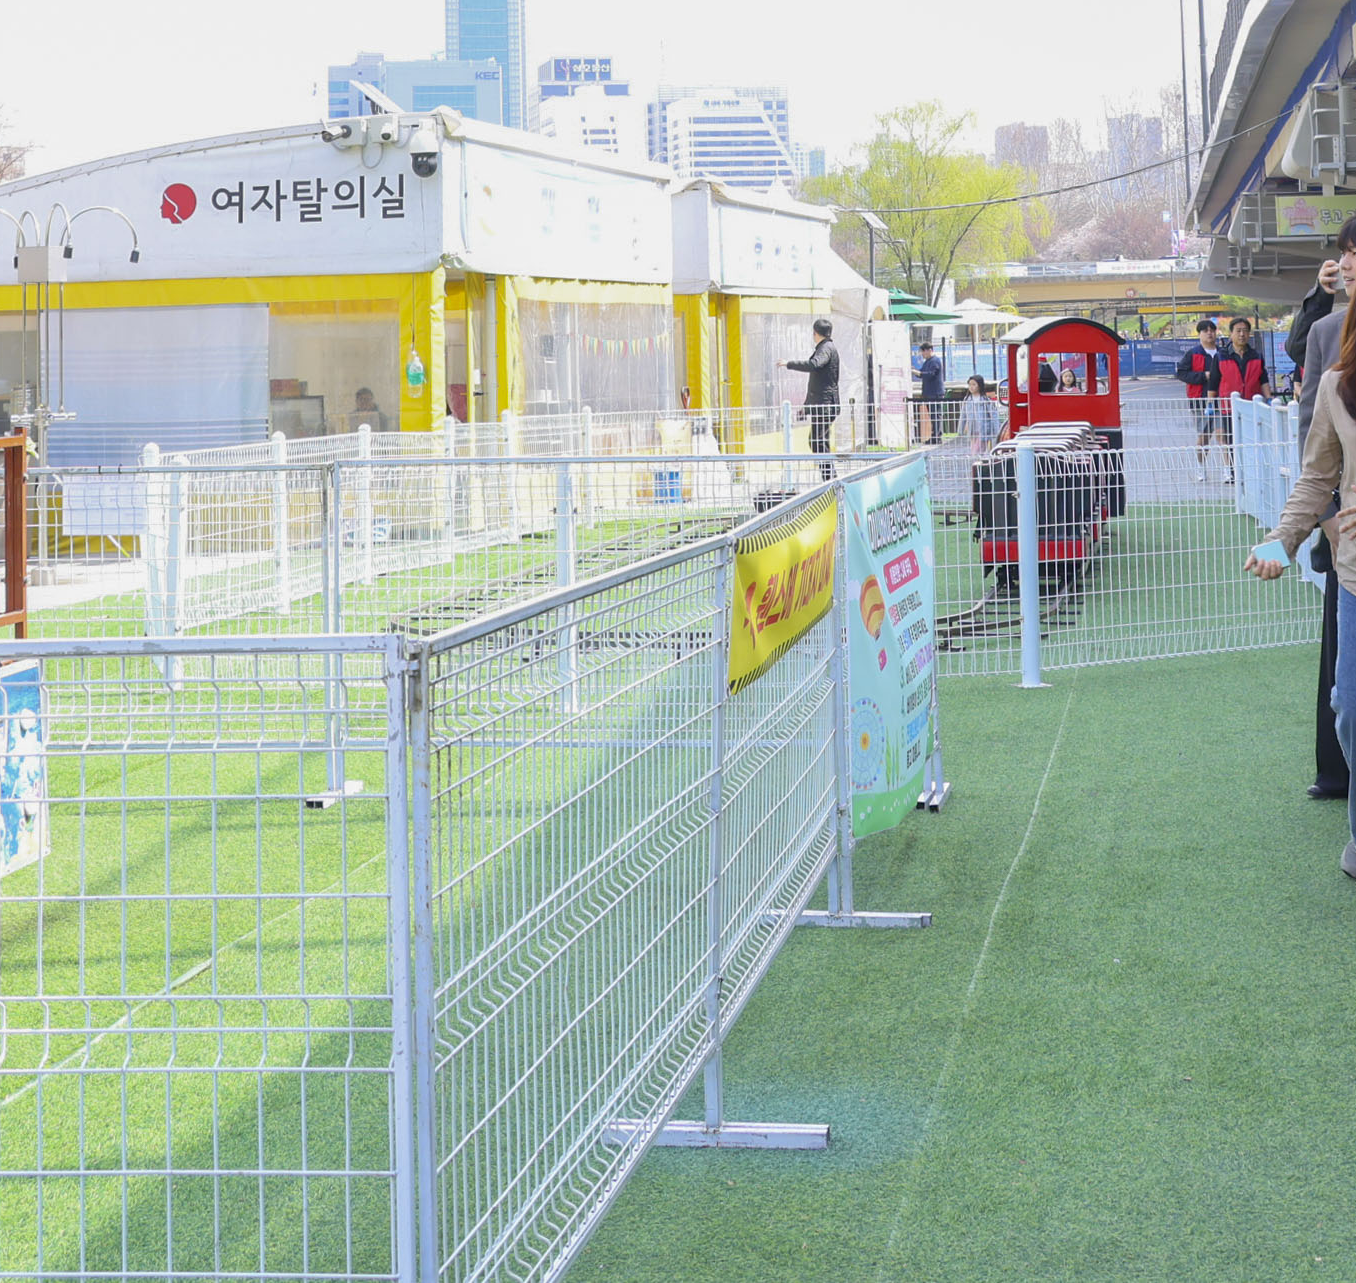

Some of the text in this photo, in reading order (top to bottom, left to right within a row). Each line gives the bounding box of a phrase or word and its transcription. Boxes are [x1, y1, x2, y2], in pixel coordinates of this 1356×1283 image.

[475, 71, 500, 80] KEC
[211, 173, 406, 224] 여자탈의실
[1320, 209, 1343, 225] 두고
